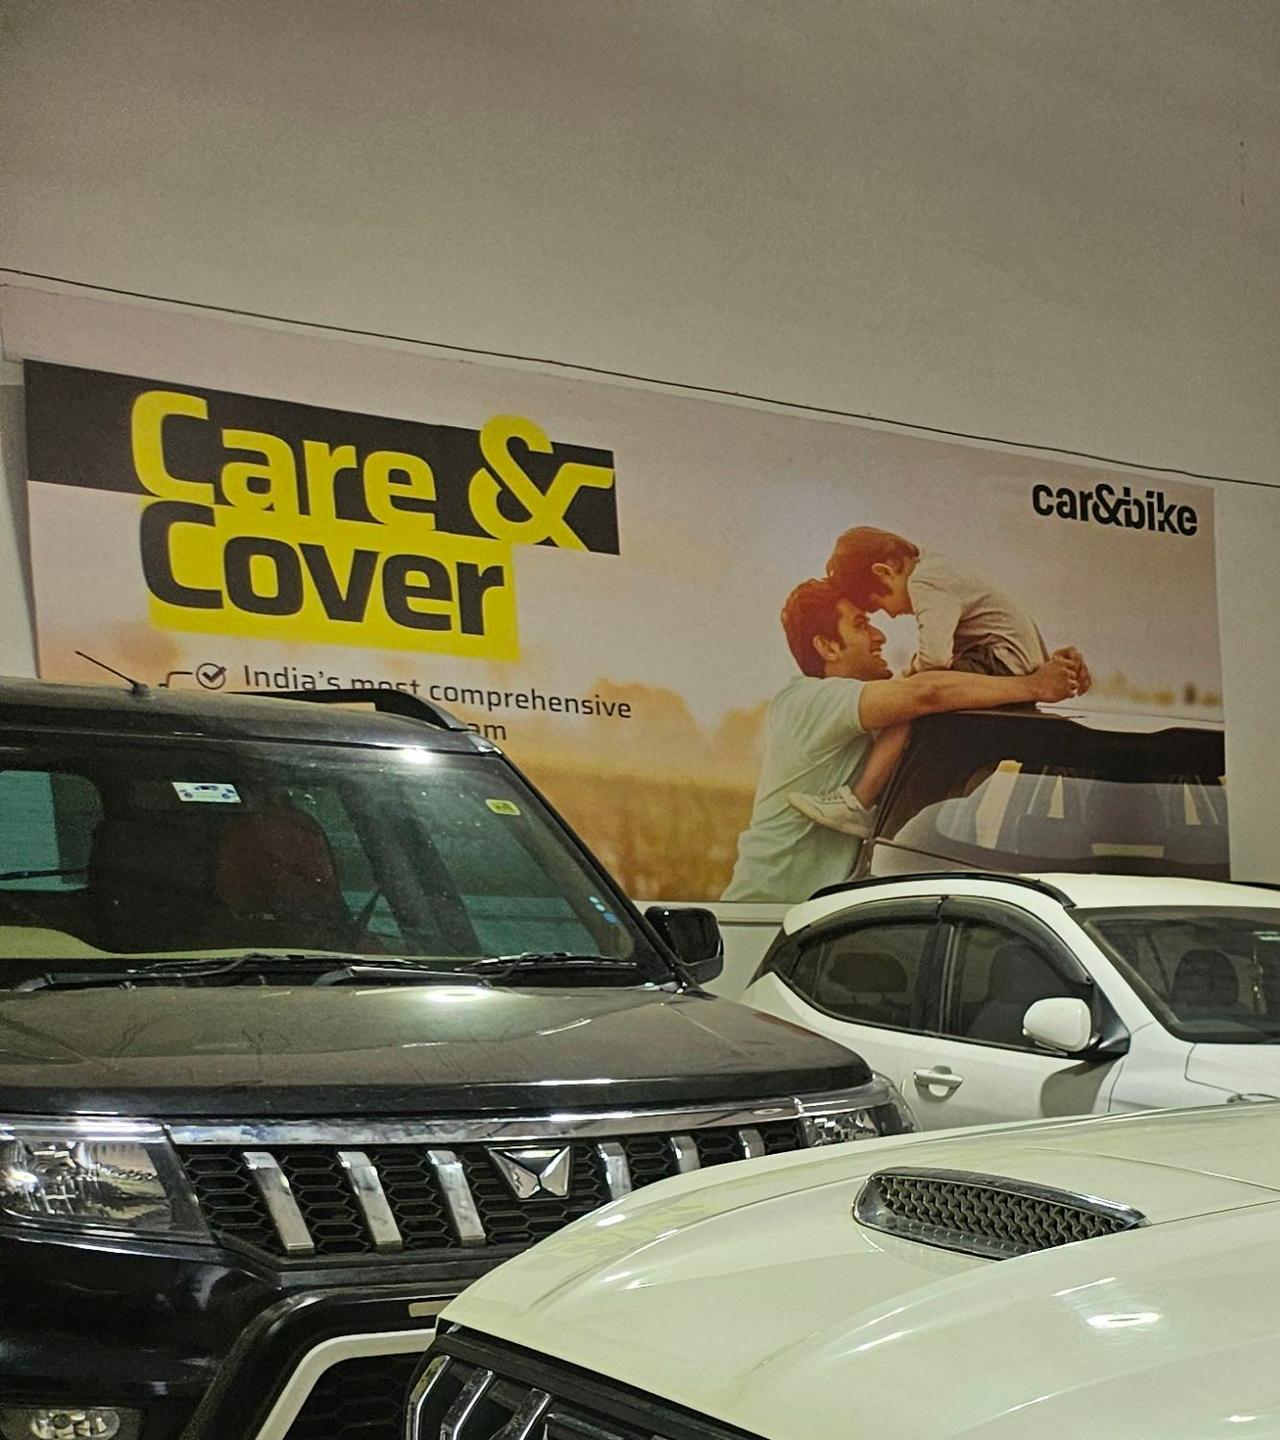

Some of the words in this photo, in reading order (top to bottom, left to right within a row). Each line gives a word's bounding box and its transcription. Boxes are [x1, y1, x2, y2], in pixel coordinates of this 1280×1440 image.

[131, 389, 438, 532] Care
[468, 414, 616, 551] &
[1032, 483, 1199, 537] car&bike
[140, 500, 506, 636] Cover
[244, 664, 341, 691] India's
[429, 684, 632, 719] comprehensive
